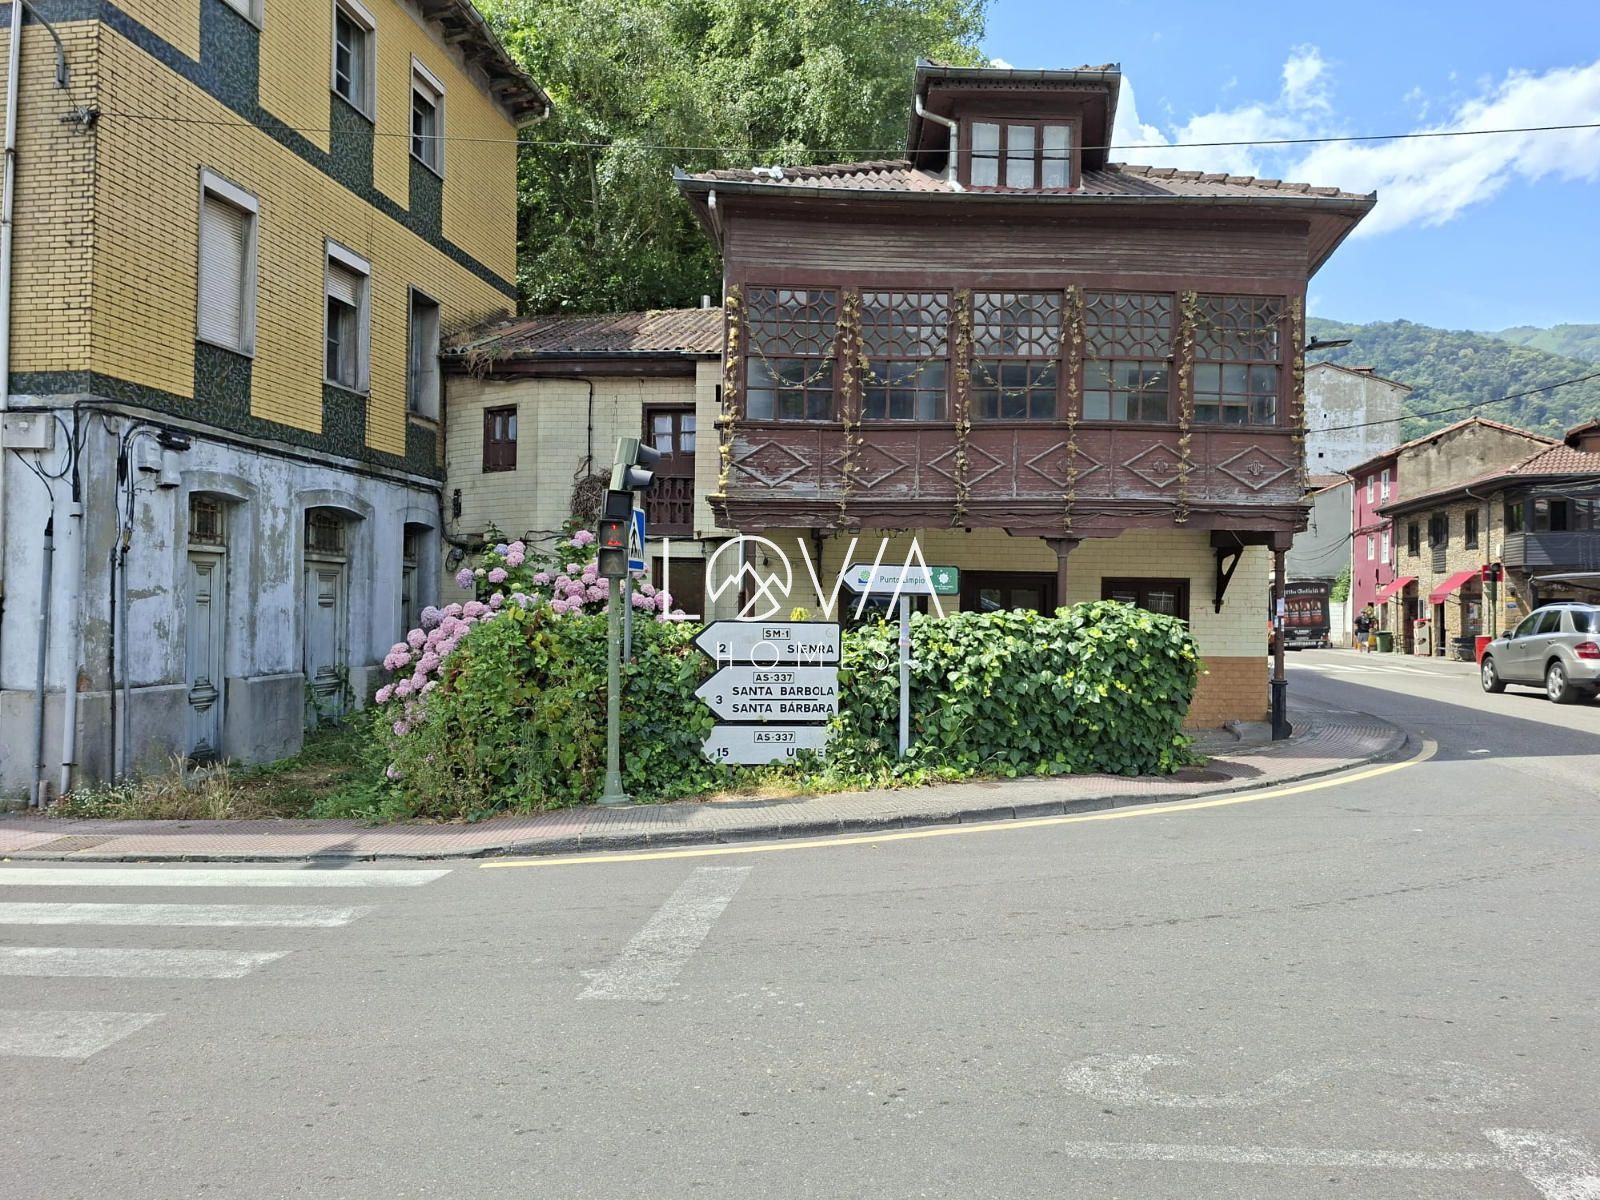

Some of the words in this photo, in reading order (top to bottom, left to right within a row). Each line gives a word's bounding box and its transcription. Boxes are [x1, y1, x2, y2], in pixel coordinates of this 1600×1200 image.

[765, 630, 789, 638] SM-1
[719, 643, 727, 653] 2
[755, 674, 793, 682] AS-337
[732, 686, 773, 696] SANTA
[780, 686, 834, 696] BARBOLA
[715, 695, 723, 705] 3
[732, 703, 773, 713] SANTA
[780, 702, 834, 713] BÁRBARA
[756, 733, 794, 741] AS-337
[717, 747, 729, 757] 15
